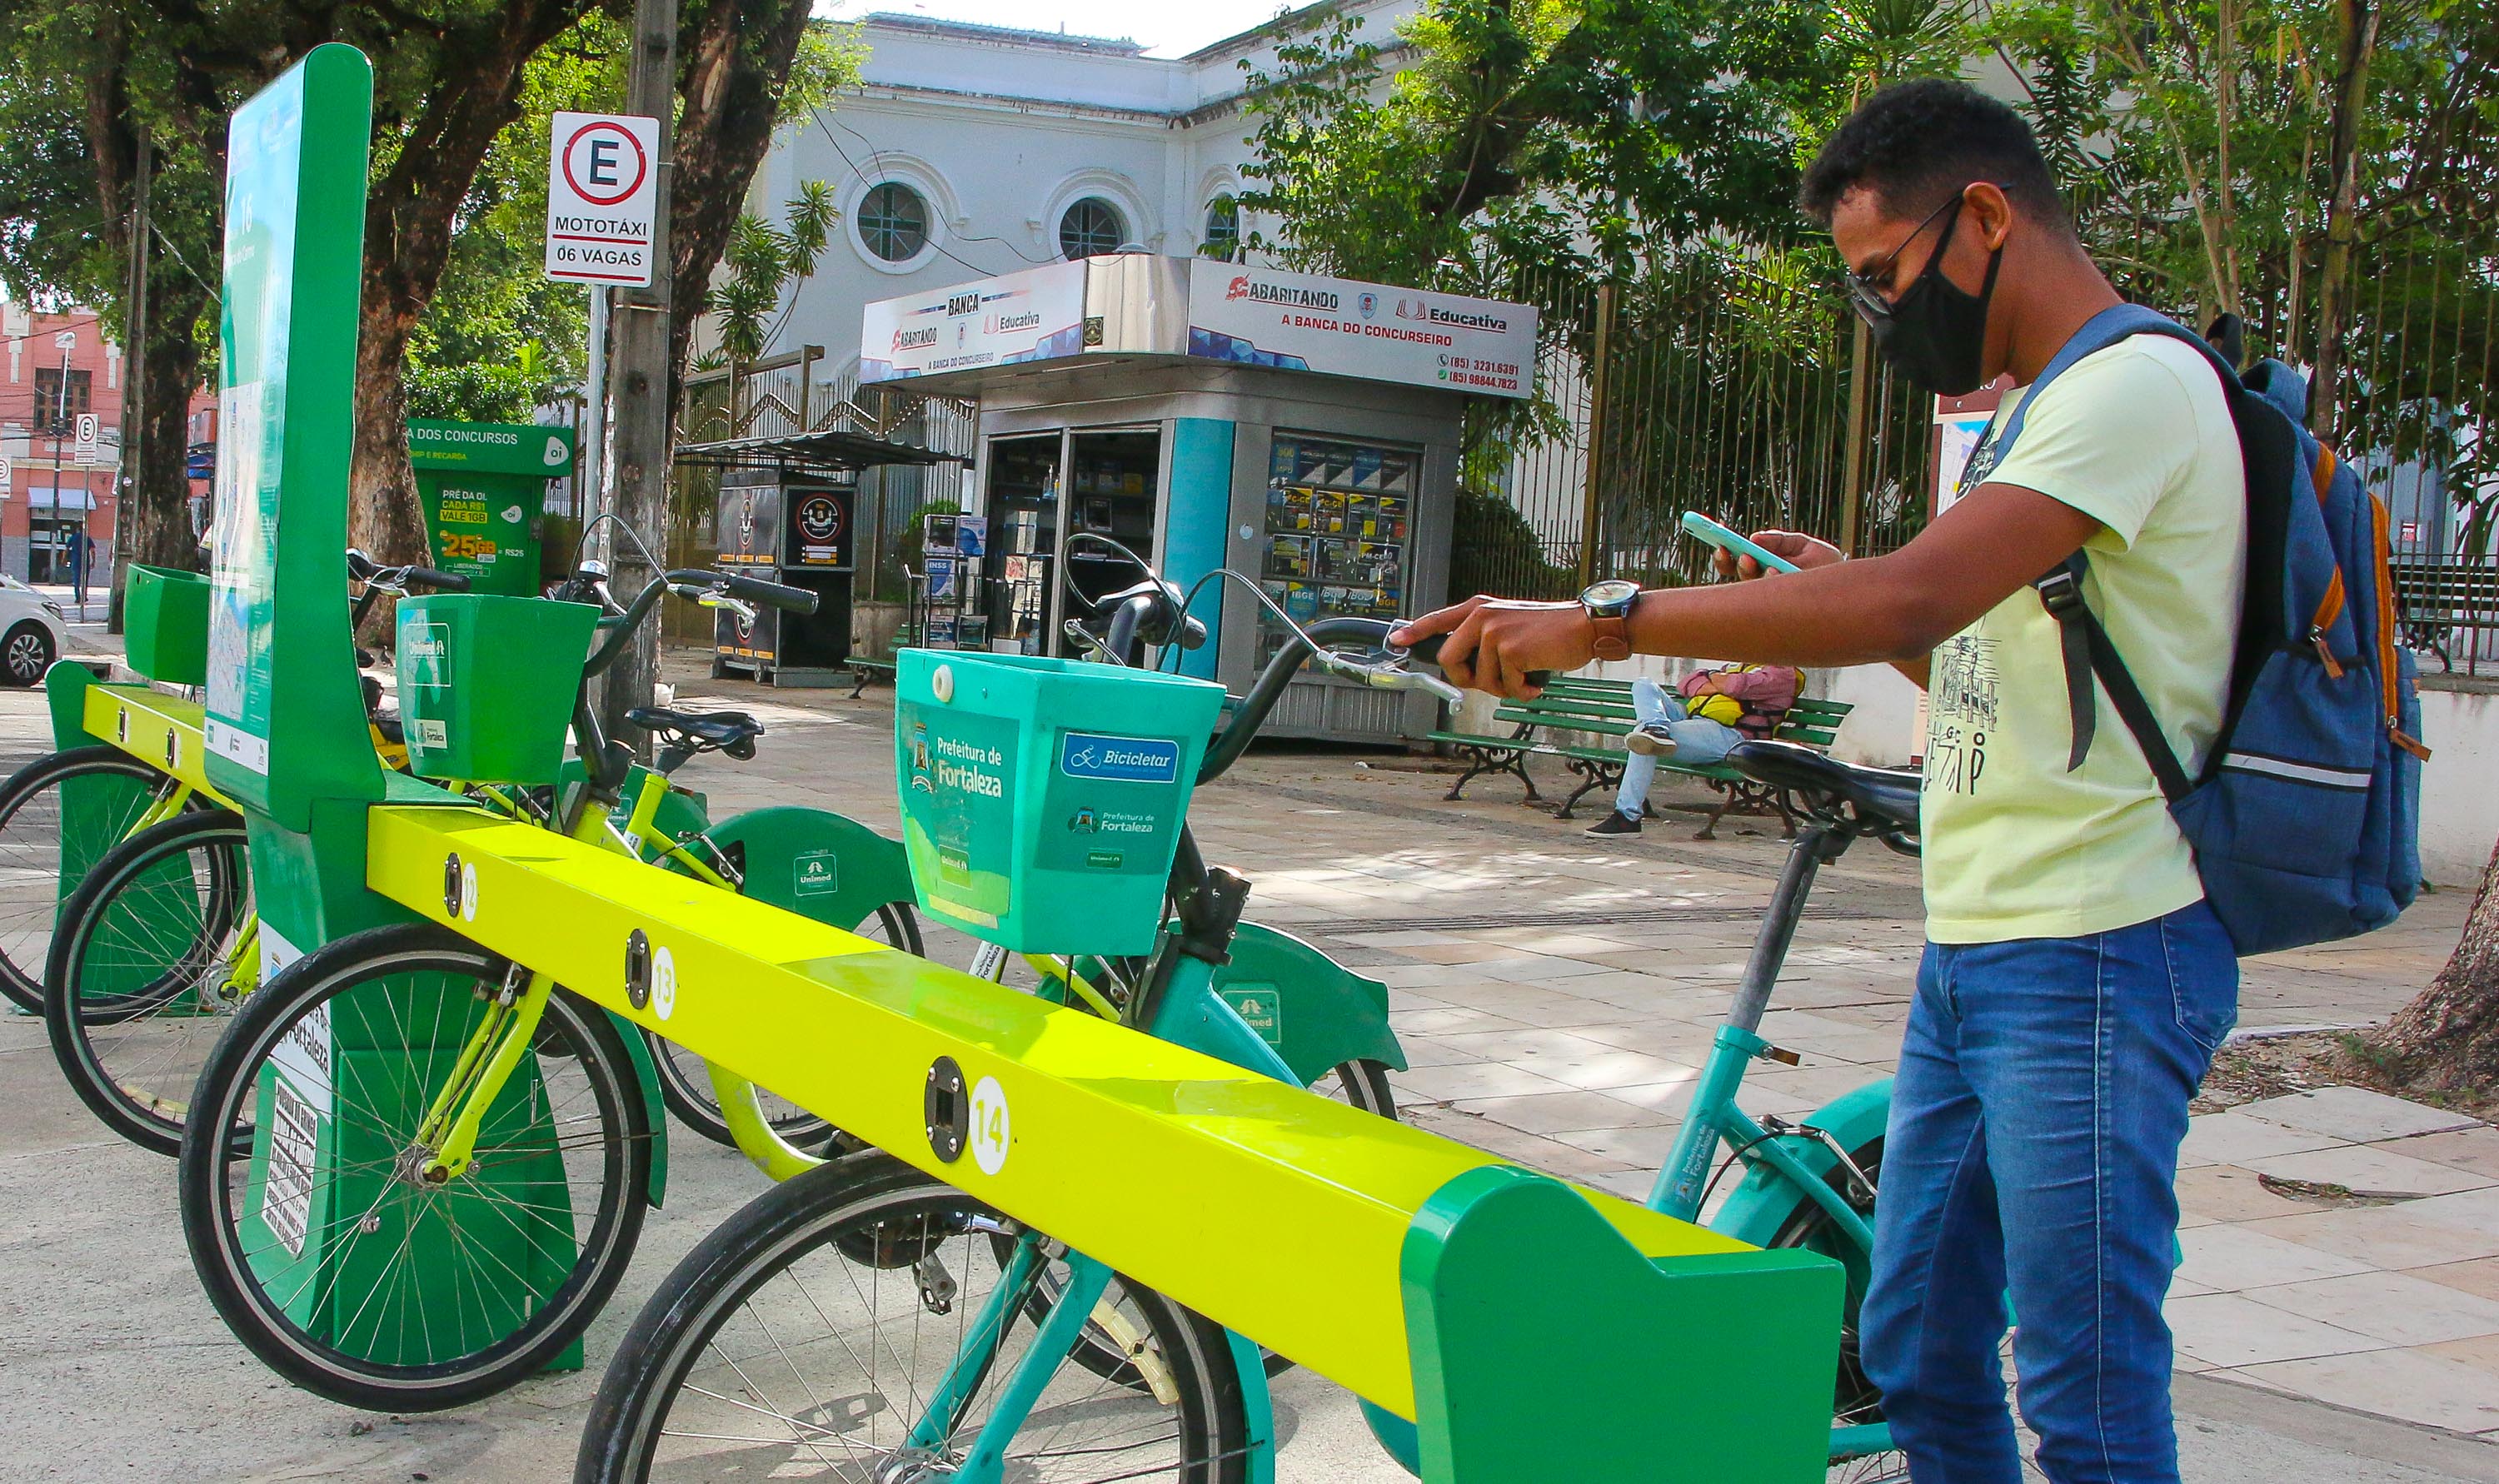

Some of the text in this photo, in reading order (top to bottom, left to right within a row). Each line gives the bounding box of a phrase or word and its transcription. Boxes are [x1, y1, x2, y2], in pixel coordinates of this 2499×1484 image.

[590, 139, 619, 187] E
[555, 216, 646, 237] MOTOTÁXI
[557, 246, 642, 266] 06 VAGAS
[948, 293, 979, 316] BANCA
[1000, 311, 1040, 331] Educativa
[1430, 307, 1507, 331] Educativa
[1282, 314, 1453, 346] A BANCA DO CONCURSEIRO
[933, 359, 949, 370] BANCA
[950, 357, 958, 367] DO
[959, 351, 994, 366] CONCURSEIRO
[1450, 356, 1519, 376] (85) 3231.6391
[1449, 371, 1517, 390] (85) 98844.7823
[83, 421, 90, 436] E
[417, 428, 441, 441] DOS
[444, 430, 518, 445] CONCURSOS
[551, 446, 562, 458] oi
[442, 489, 461, 499] PRÉ
[462, 491, 475, 500] DA
[442, 500, 467, 510] CADA
[441, 511, 486, 522] VALE 1GB
[1292, 591, 1314, 600] IBGE
[937, 736, 1002, 766] Prefeitura de
[1103, 749, 1171, 767] Bicicletar
[937, 759, 1002, 798] Fortaleza
[1101, 821, 1154, 833] Fortaleza
[1103, 812, 1155, 822] Prefeitura de
[800, 874, 831, 884] Unimed
[464, 877, 475, 909] 12
[980, 946, 1001, 980] Fortaleza
[656, 964, 671, 1003] 13
[289, 1022, 329, 1074] ortaleza
[975, 1099, 1003, 1153] 14
